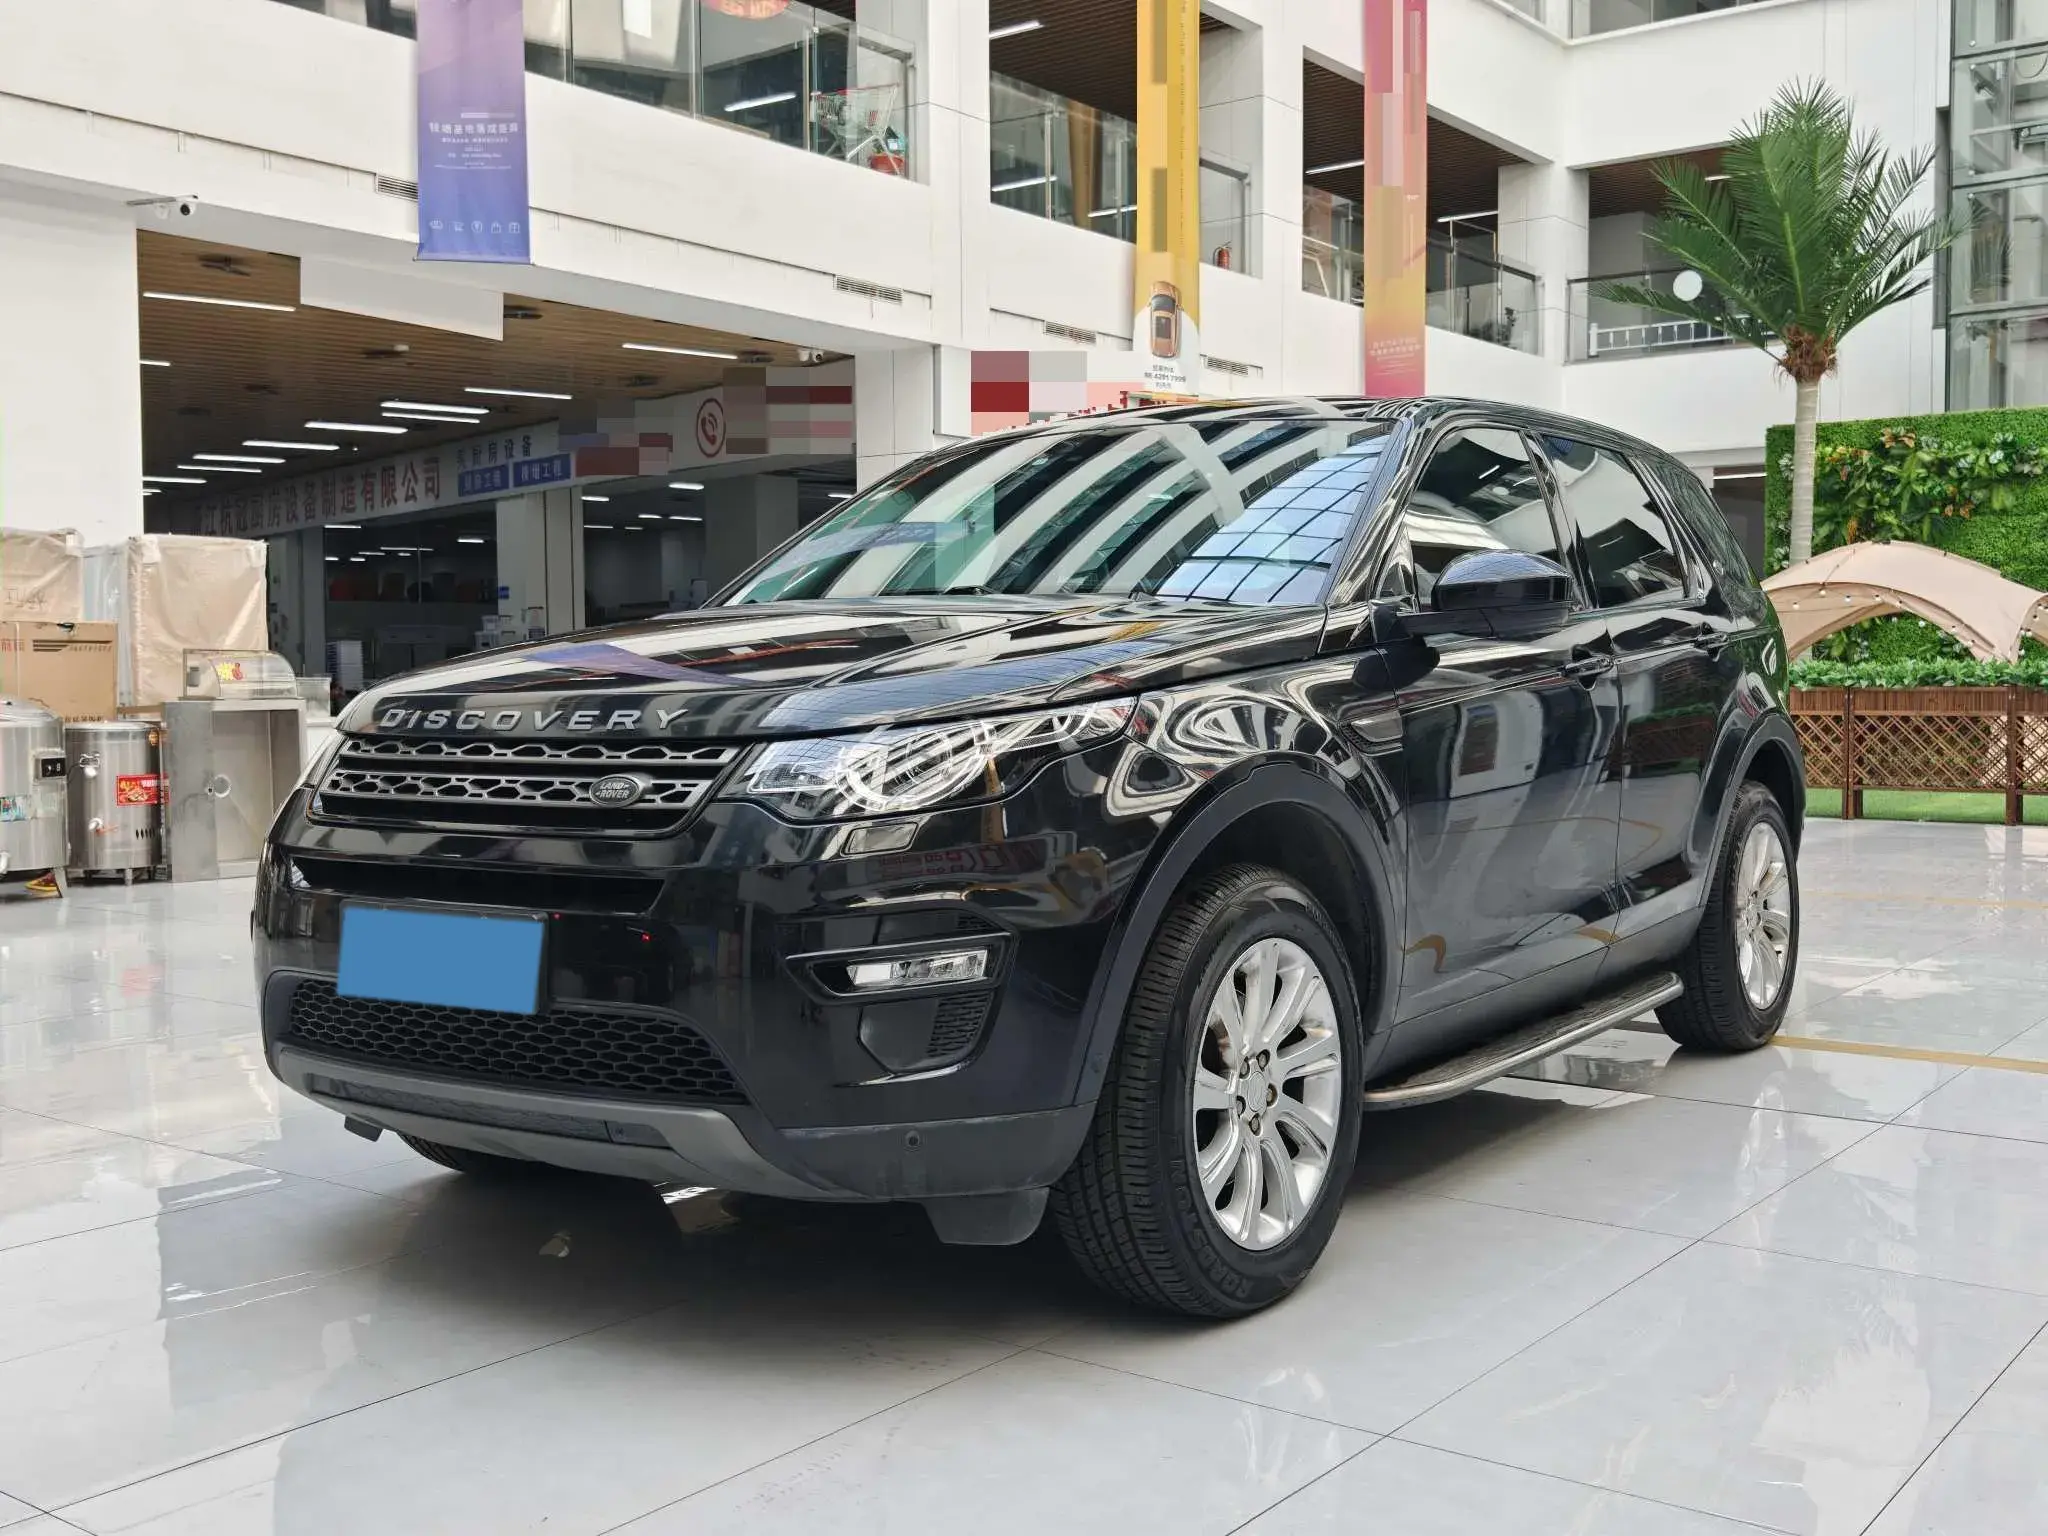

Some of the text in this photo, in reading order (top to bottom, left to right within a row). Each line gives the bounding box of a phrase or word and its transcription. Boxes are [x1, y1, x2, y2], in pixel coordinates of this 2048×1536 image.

[379, 709, 689, 731] DISCOVERY
[600, 782, 625, 790] LAND
[599, 789, 630, 799] ROVER
